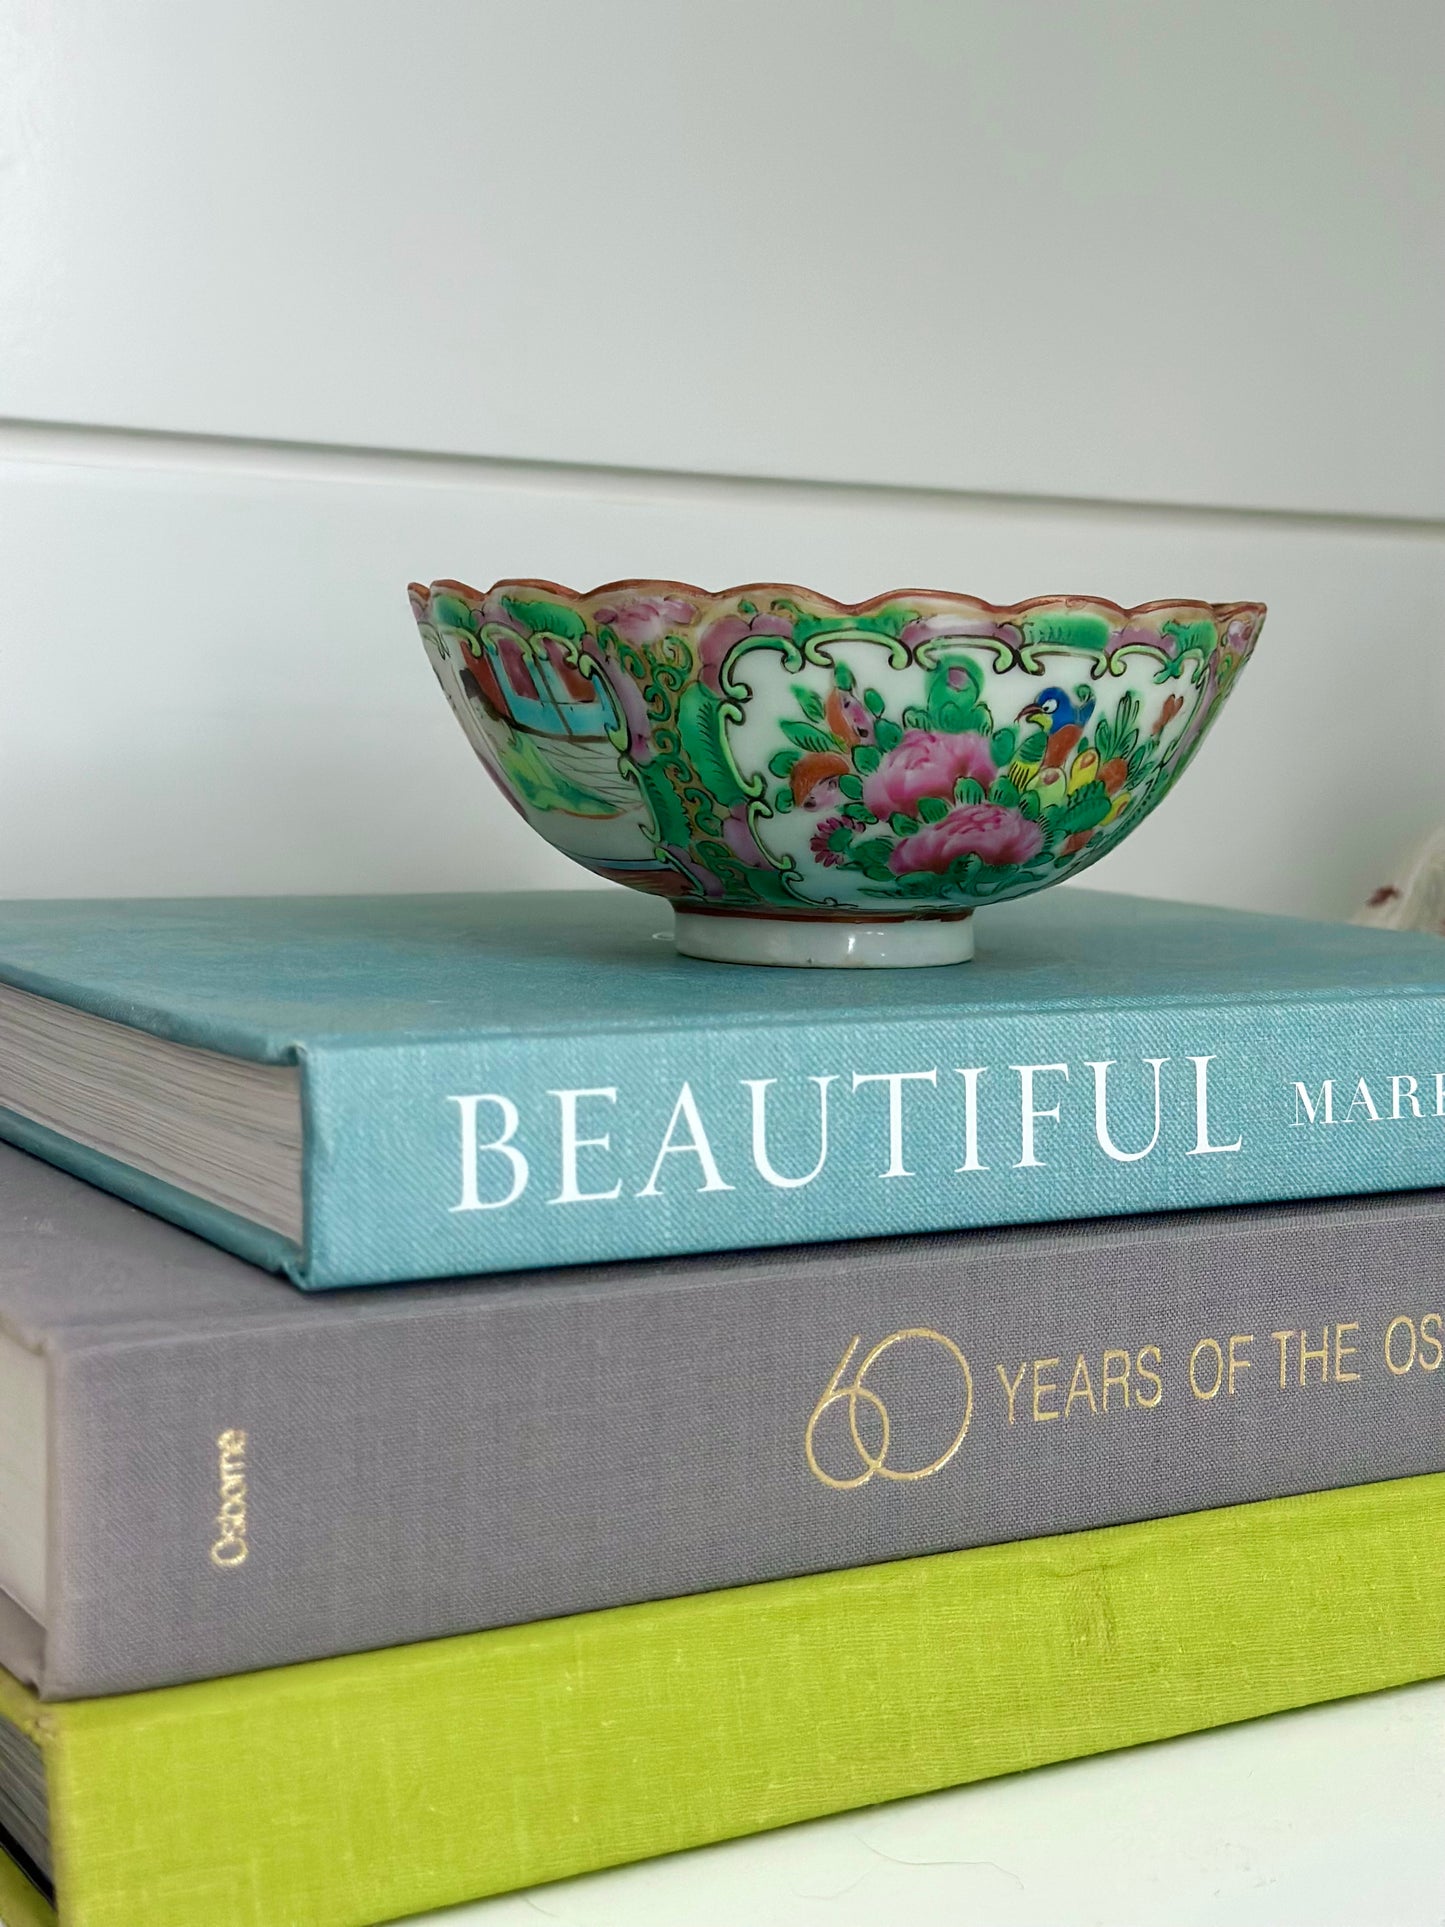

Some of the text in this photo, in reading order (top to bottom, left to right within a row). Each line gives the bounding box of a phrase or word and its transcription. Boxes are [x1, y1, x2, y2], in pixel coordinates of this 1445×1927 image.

[446, 1054, 1245, 1213] BEAUTIFUL
[804, 1313, 1444, 1490] 60 YEARS OF THE OS
[210, 1428, 250, 1568] Osborne
